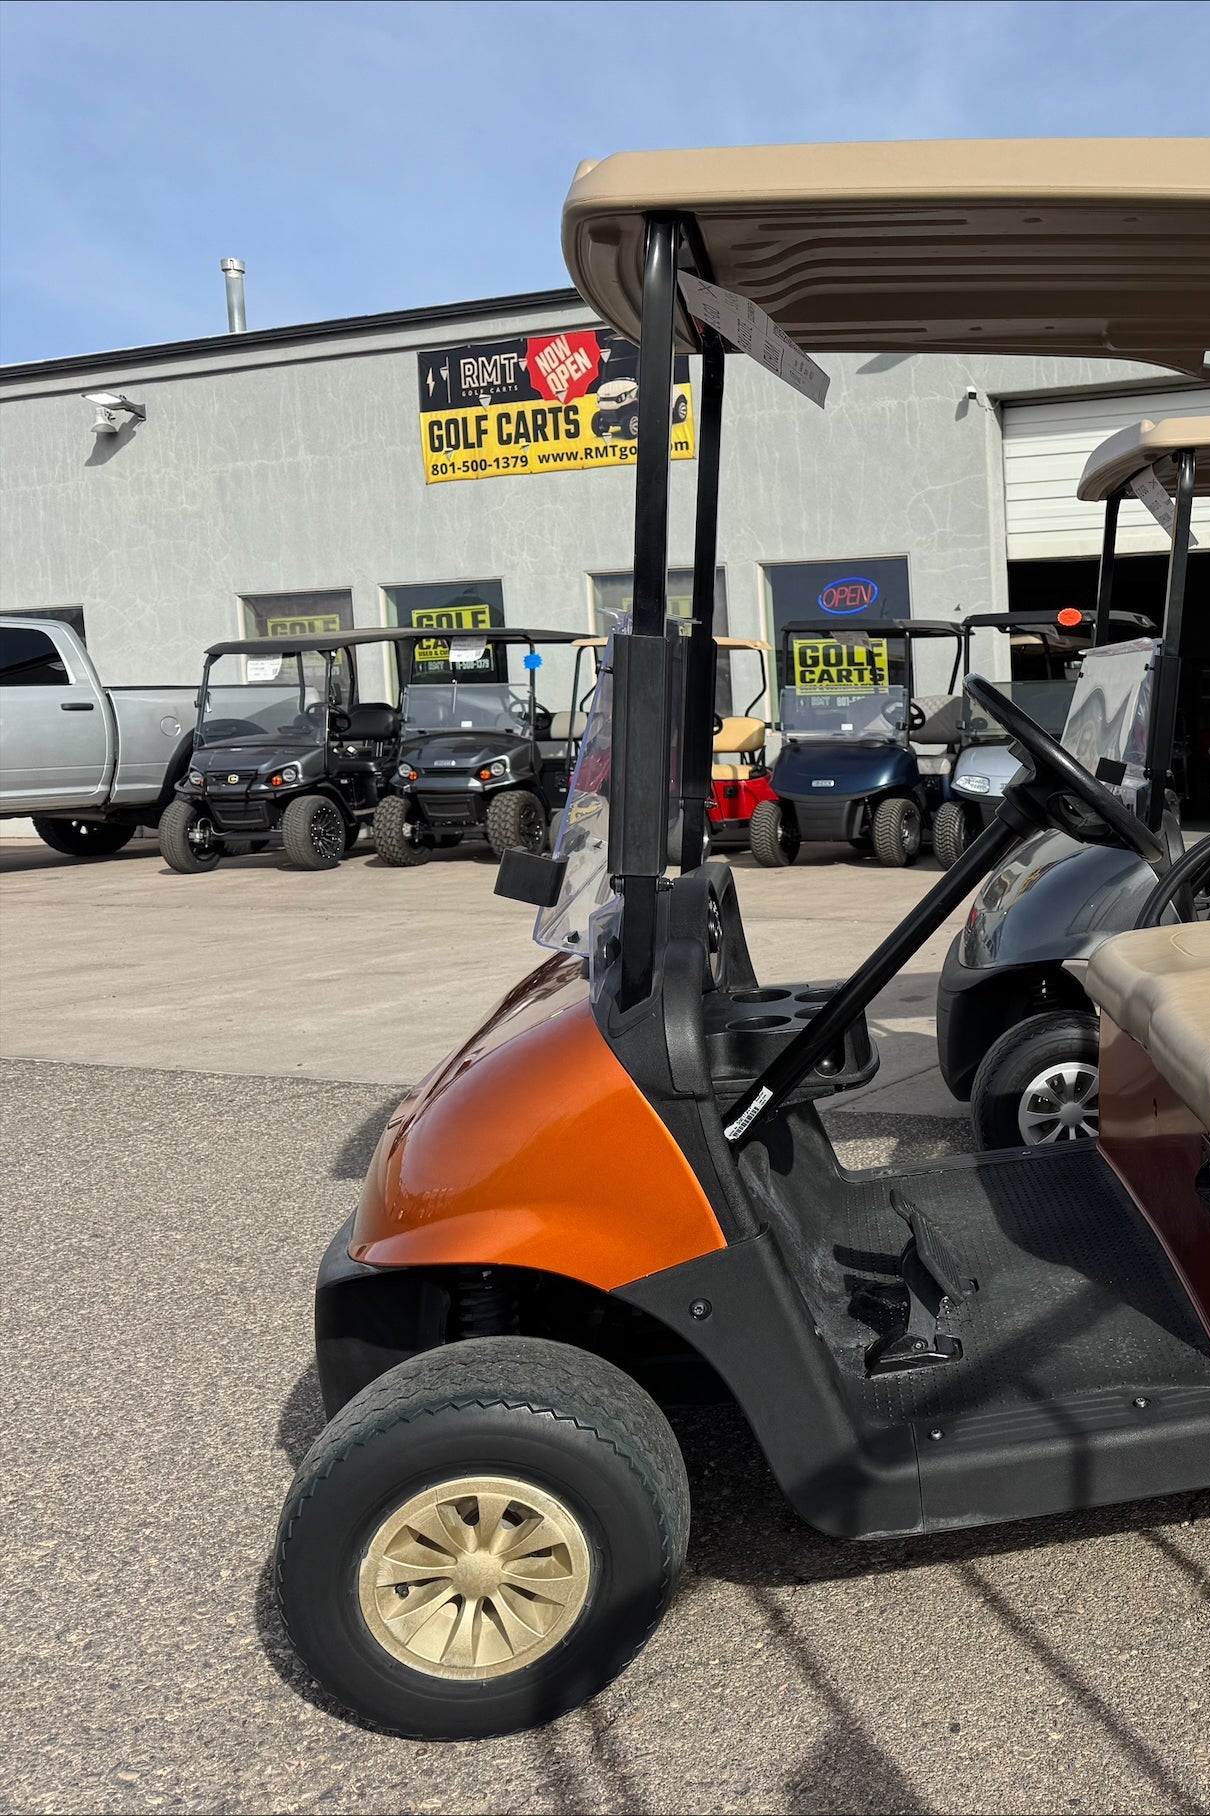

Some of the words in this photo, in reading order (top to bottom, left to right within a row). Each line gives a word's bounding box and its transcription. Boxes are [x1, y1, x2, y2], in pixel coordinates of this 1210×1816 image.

[534, 334, 572, 377] NOW
[460, 353, 518, 389] RMT
[546, 347, 593, 394] OPEN
[490, 385, 519, 394] CARTS
[428, 415, 489, 453] GOLF
[497, 405, 580, 446] CARTS
[431, 455, 529, 476] 801-500-1379
[822, 583, 873, 608] OPEN
[798, 642, 883, 668] GOLF
[800, 667, 885, 684] CARTS
